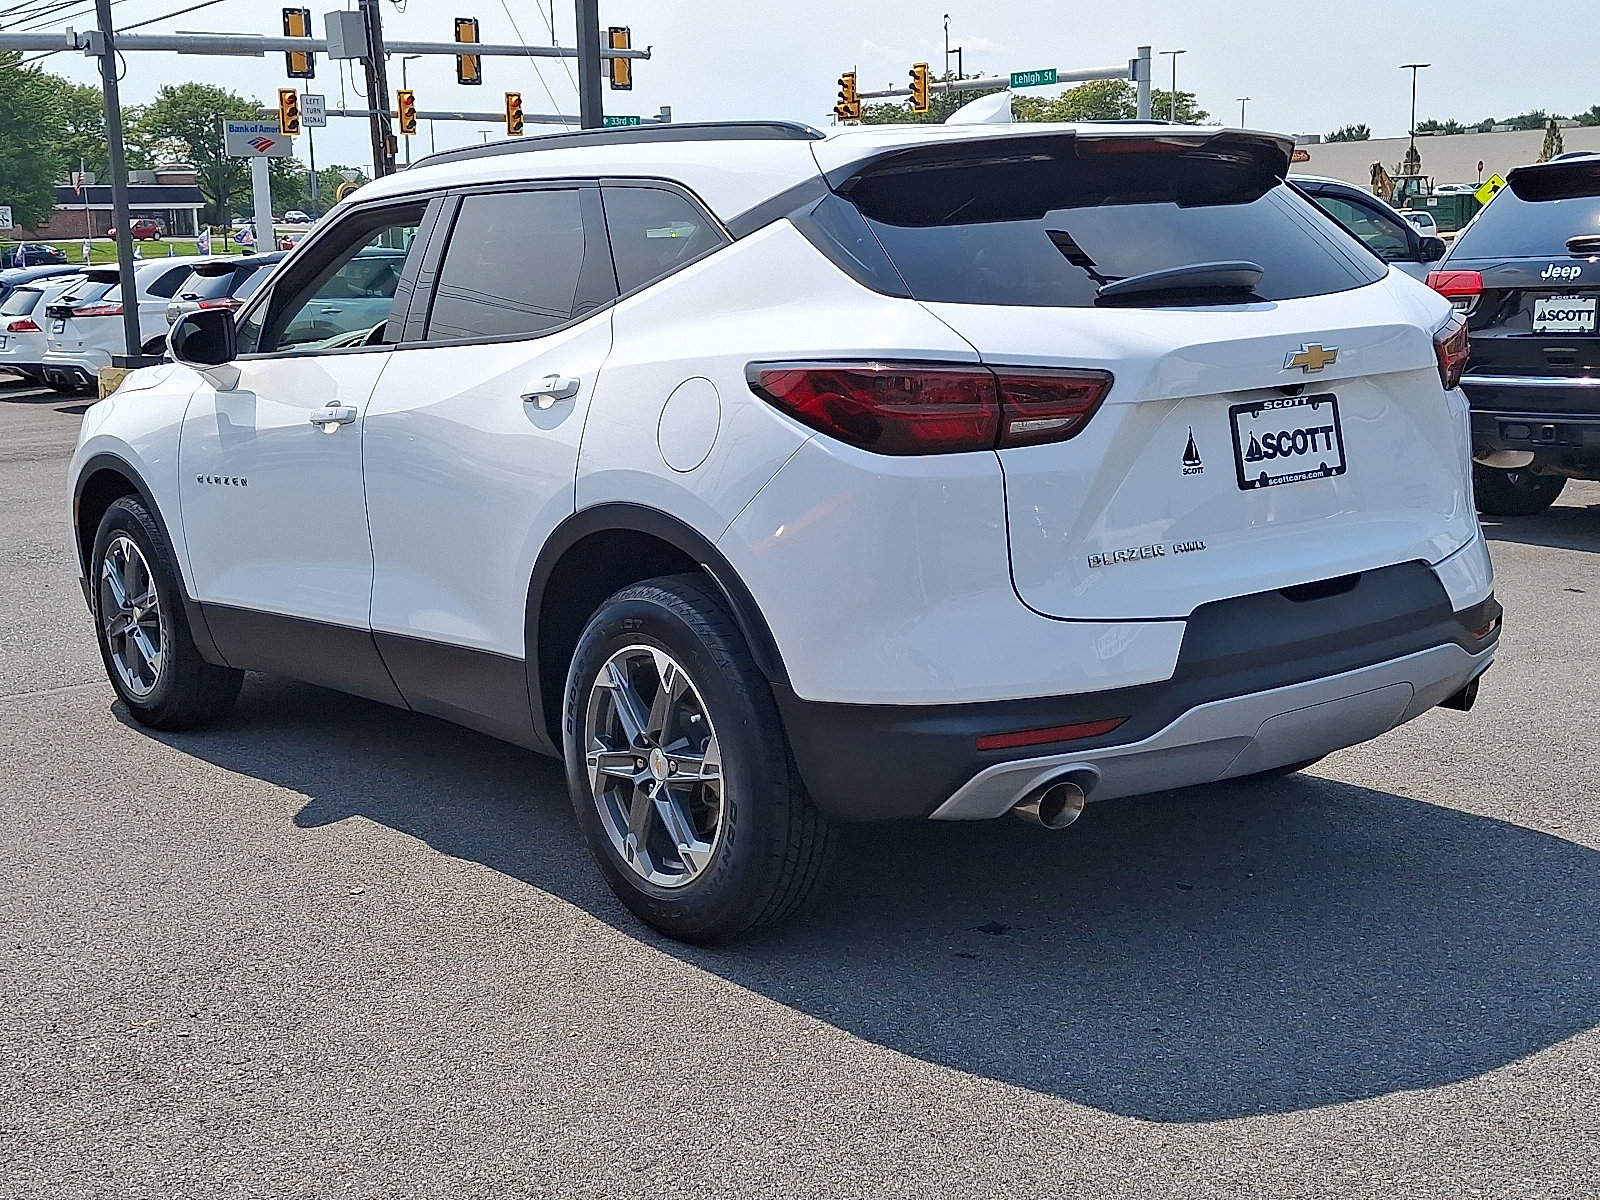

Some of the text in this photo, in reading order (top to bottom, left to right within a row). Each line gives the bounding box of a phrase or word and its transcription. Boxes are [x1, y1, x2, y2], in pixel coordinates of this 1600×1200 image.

[1014, 71, 1053, 84] Lehigh St
[611, 117, 627, 126] 33rd
[228, 124, 281, 134] Bank of Ameri
[1541, 263, 1582, 280] Jeep
[1547, 309, 1594, 322] SCOTT
[1263, 397, 1309, 410] SCOTT
[1262, 424, 1334, 460] SCOTT
[1182, 466, 1205, 476] SCOTT
[196, 473, 248, 487] BLAZER
[1268, 470, 1325, 486] scottcars.com
[1087, 540, 1207, 569] BLAZER AWD
